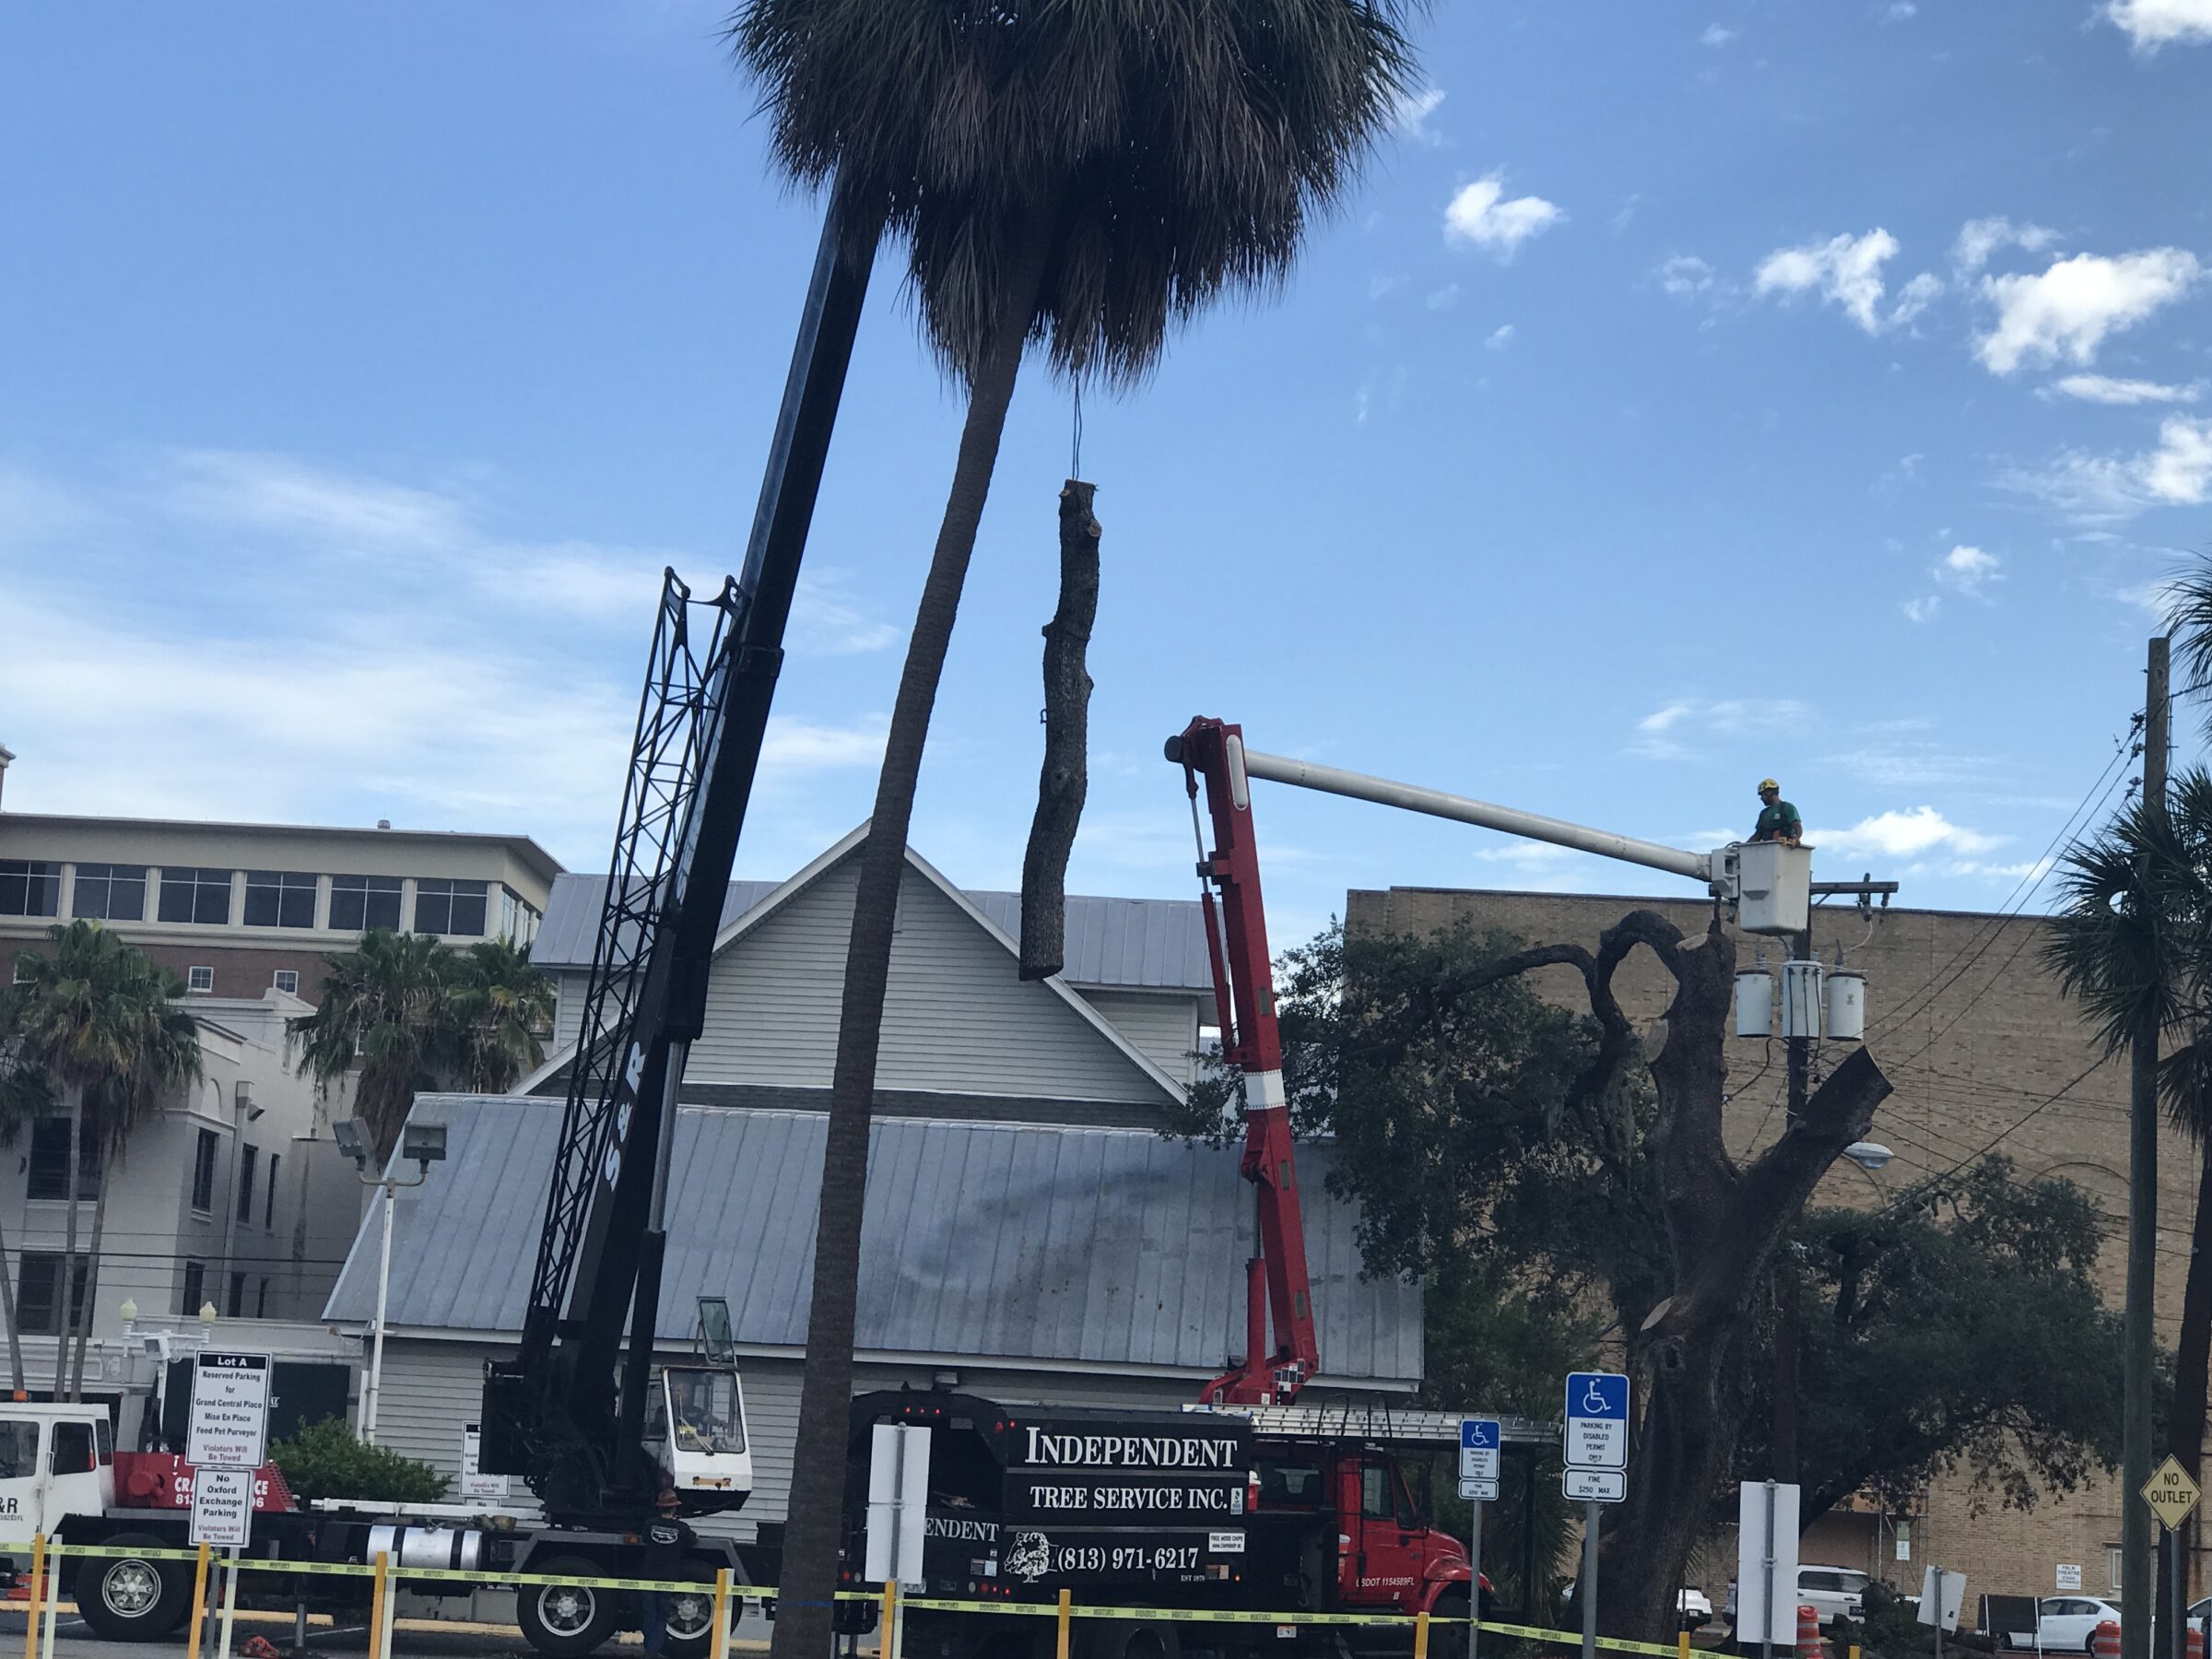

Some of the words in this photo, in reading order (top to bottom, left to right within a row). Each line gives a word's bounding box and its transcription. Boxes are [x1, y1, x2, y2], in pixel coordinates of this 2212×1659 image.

[625, 1041, 646, 1094] R
[218, 1357, 236, 1366] Lot
[239, 1358, 248, 1367] A
[202, 1371, 233, 1380] Reserved
[235, 1372, 261, 1382] Parking
[226, 1385, 235, 1394] for
[195, 1398, 216, 1406] Grand
[218, 1399, 241, 1407] Central
[232, 1414, 251, 1422] Place
[227, 1429, 257, 1438] Purveyor
[203, 1444, 233, 1453] Violators
[1025, 1427, 1238, 1467] INDEPENDENT
[219, 1453, 241, 1462] Towed
[2163, 1473, 2179, 1486] NO
[207, 1486, 237, 1494] Oxford
[1030, 1486, 1088, 1509] TREE
[1093, 1487, 1182, 1510] SERVICE
[1187, 1488, 1229, 1510] INC.
[2151, 1490, 2193, 1503] OUTLET
[199, 1497, 242, 1507] Exchange
[203, 1508, 237, 1519] Parking
[924, 1517, 999, 1542] ENDENT
[1058, 1547, 1106, 1572] (813)
[1112, 1547, 1199, 1569] 971-6217
